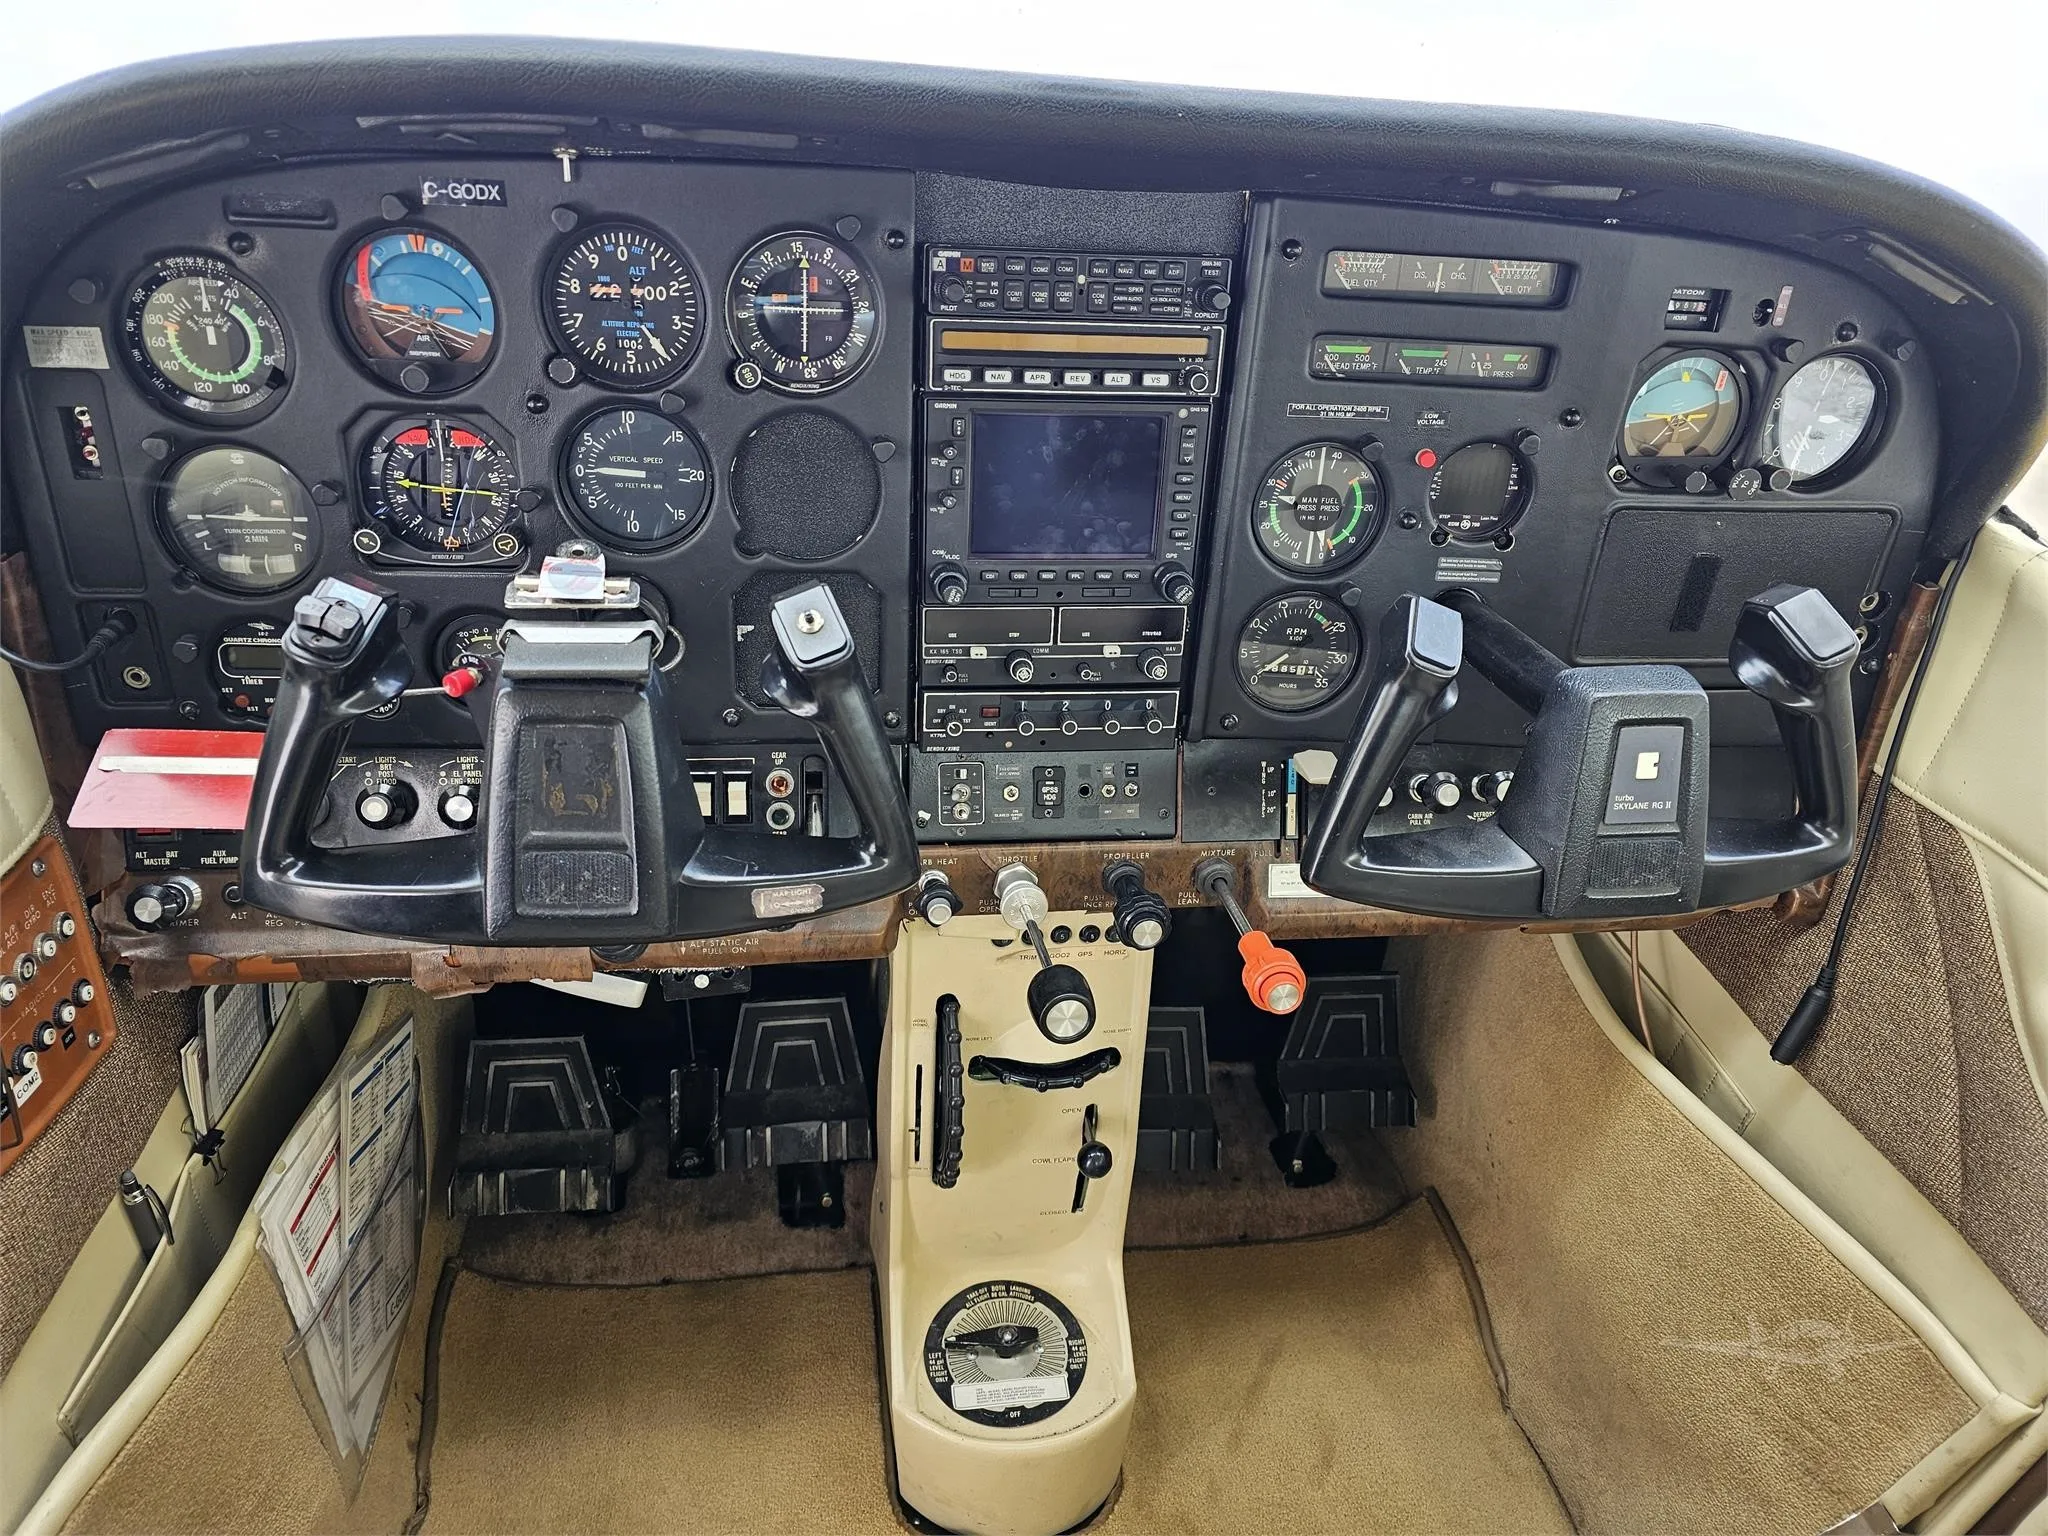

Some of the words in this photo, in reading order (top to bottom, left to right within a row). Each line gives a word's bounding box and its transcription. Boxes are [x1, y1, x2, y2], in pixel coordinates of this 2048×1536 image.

[423, 181, 501, 202] C-GODX
[790, 242, 803, 253] 15
[759, 251, 775, 266] 12
[629, 266, 647, 276] ALT
[845, 269, 860, 284] 21
[152, 293, 175, 305] 200
[857, 301, 869, 315] 24
[145, 314, 165, 325] 180
[616, 330, 640, 338] ELECTRIC
[147, 337, 167, 348] 160
[1355, 353, 1370, 362] 500
[1434, 359, 1448, 367] 245
[159, 360, 179, 371] 140
[831, 356, 847, 371] 30
[742, 366, 756, 384] OBS
[804, 367, 818, 379] 33
[949, 372, 966, 380] HDG
[194, 382, 213, 393] 120
[232, 383, 251, 394] 100
[621, 411, 635, 424] 10
[671, 431, 684, 443] 15
[689, 470, 705, 482] 20
[1731, 472, 1746, 489] PULL
[1741, 479, 1750, 490] TO
[1747, 478, 1761, 496] CAGE
[1259, 500, 1268, 508] 25
[674, 510, 686, 521] 15
[627, 520, 640, 532] 10
[244, 535, 252, 543] 2
[252, 535, 269, 543] MIN
[1308, 599, 1322, 609] 20
[1286, 627, 1307, 636] RPM
[1333, 622, 1346, 632] 25
[1314, 679, 1329, 688] 35
[374, 756, 396, 764] LIGHTS
[456, 756, 479, 764] LIGHTS
[135, 851, 148, 859] ALT
[1103, 852, 1150, 860] PROPELLER
[1200, 849, 1236, 857] MIXTURE
[143, 858, 170, 866] MASTER
[997, 855, 1038, 863] THROTTLE
[789, 887, 812, 896] LIGHT
[24, 910, 41, 930] GYRO
[230, 911, 248, 920] ALT
[264, 919, 284, 927] REG
[690, 939, 708, 948] ALT
[710, 939, 742, 947] STATIC
[745, 937, 759, 946] AIR
[731, 946, 747, 954] ON
[16, 1071, 40, 1100] COM2
[1009, 1410, 1021, 1418] OFF
